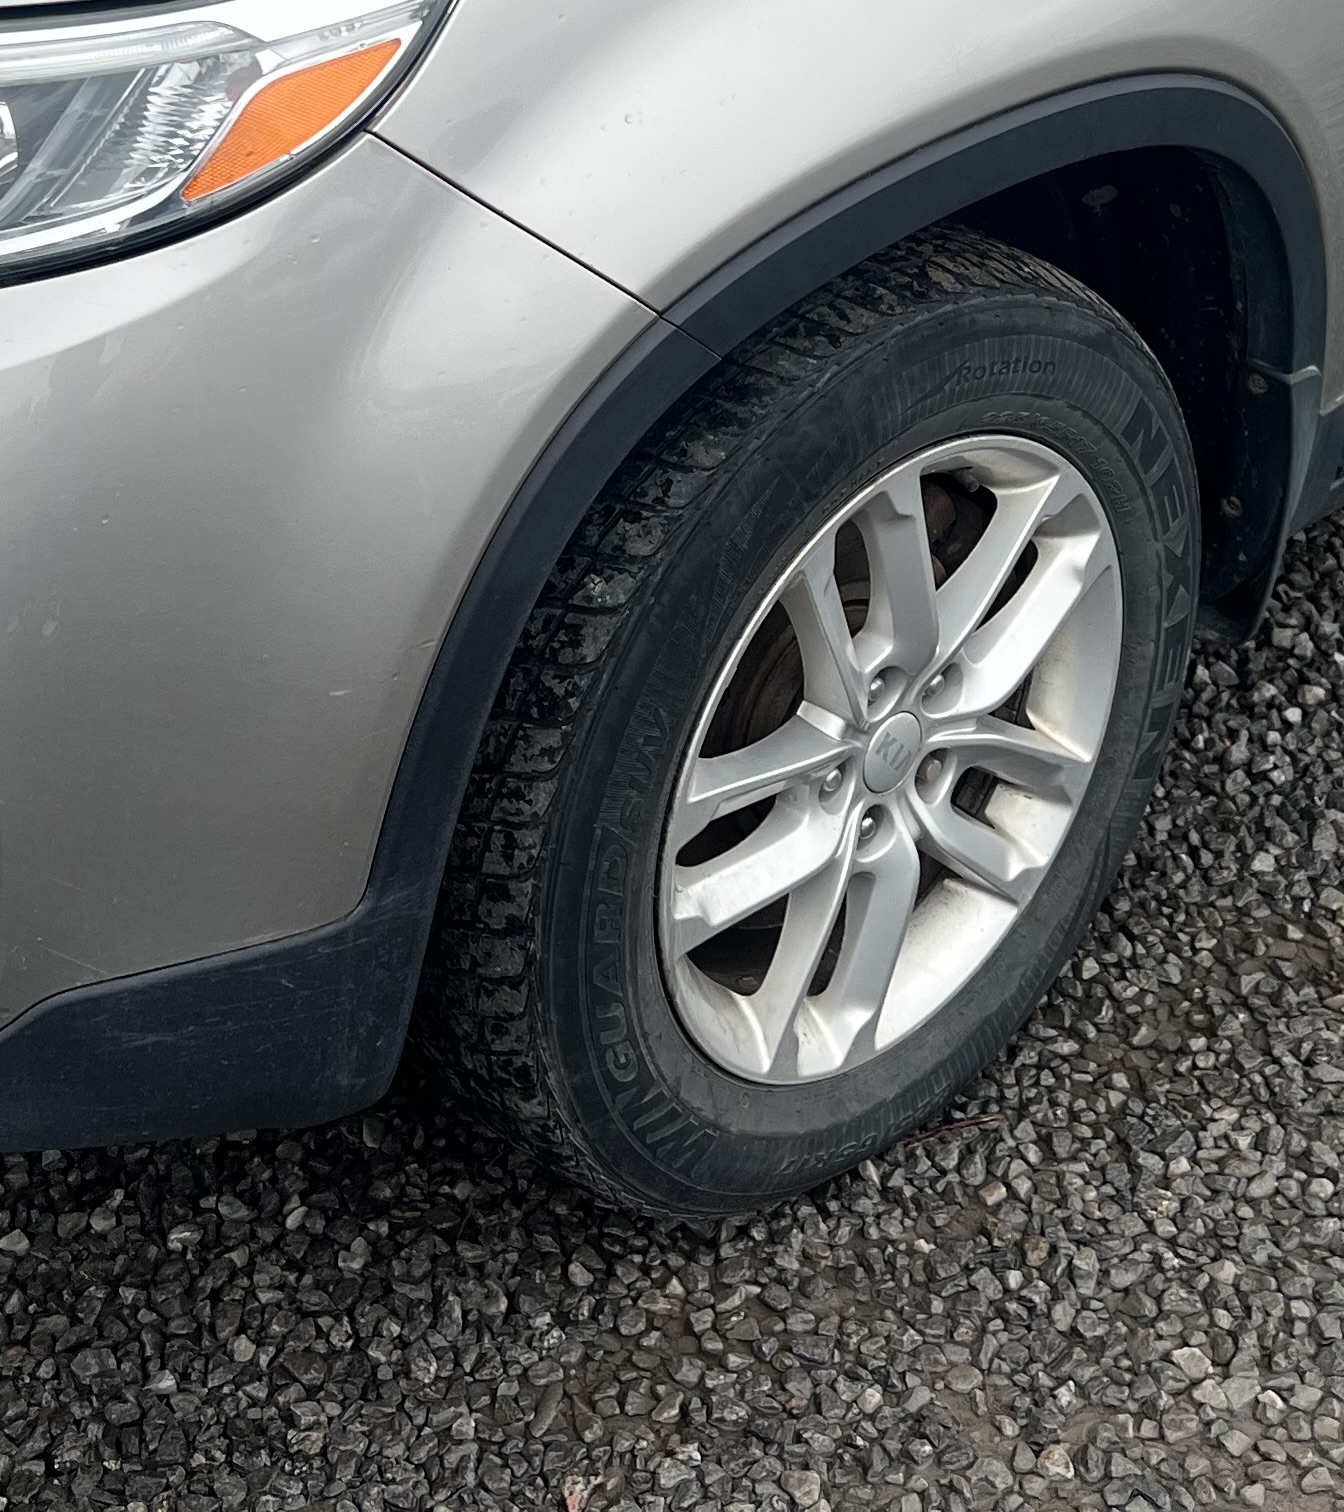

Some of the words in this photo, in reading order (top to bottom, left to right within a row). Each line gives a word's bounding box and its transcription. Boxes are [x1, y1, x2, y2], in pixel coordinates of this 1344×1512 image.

[953, 352, 1056, 387] Rotation
[1119, 396, 1192, 781] NEXEN
[874, 730, 913, 776] KIA
[592, 840, 720, 1178] WINGUARD
